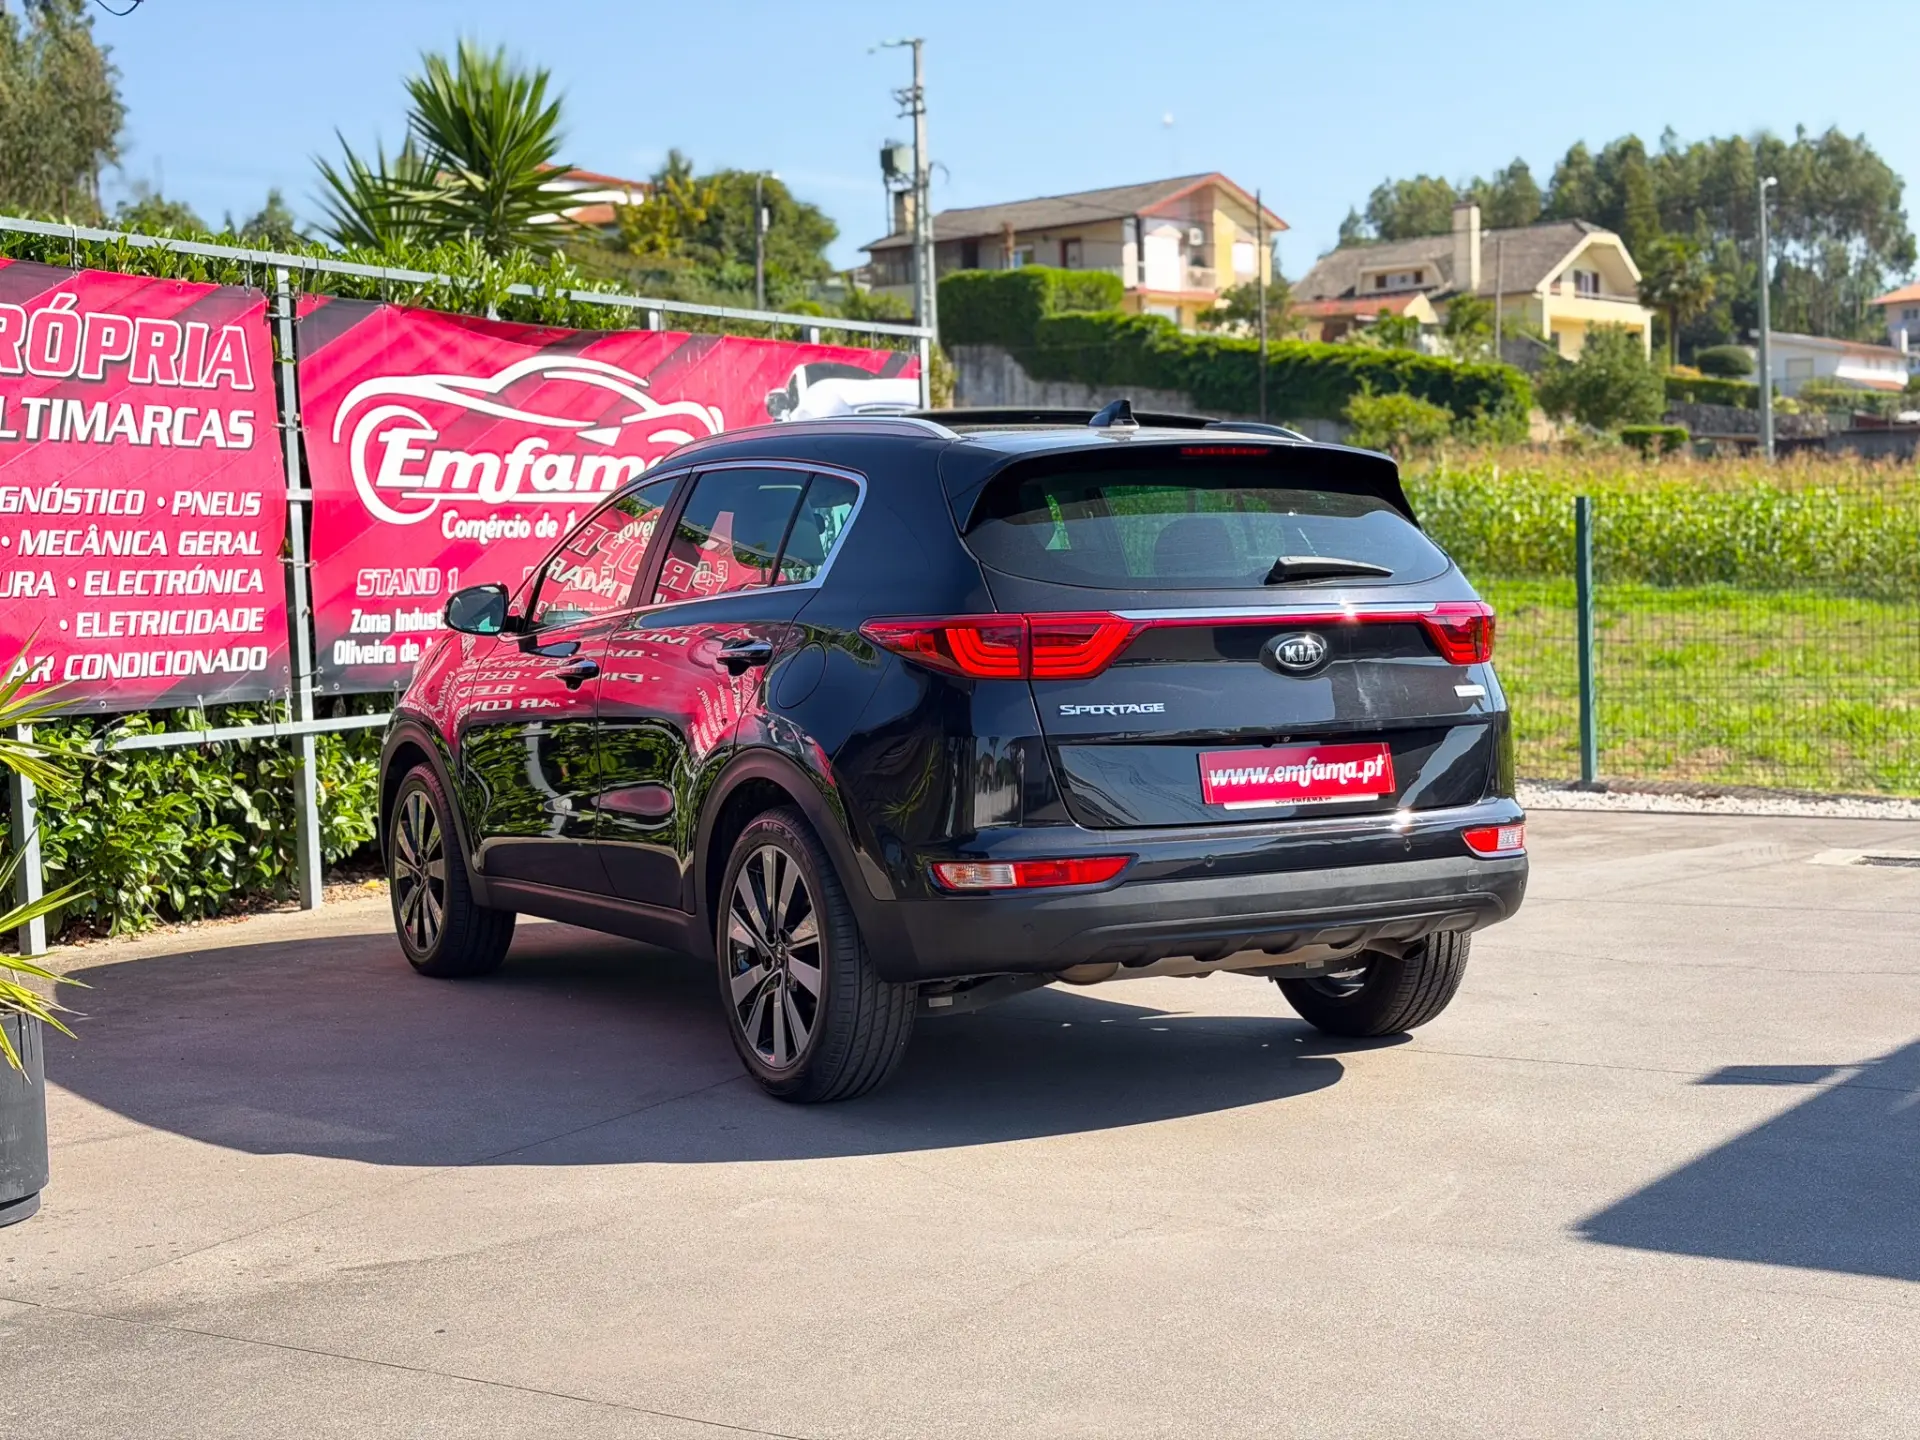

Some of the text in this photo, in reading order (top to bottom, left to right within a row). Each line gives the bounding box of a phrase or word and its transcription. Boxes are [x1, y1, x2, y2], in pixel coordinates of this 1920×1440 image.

[375, 427, 662, 505] Emfam
[0, 482, 262, 518] GNÓSTICO PNEUS
[18, 524, 262, 557] MECÂNICA GERAL
[442, 507, 531, 544] Comércio
[535, 512, 559, 539] de
[84, 564, 264, 597] ELECTRÓNICA
[356, 567, 459, 597] STAND 1
[76, 607, 265, 639] ELETRICIDADE
[350, 607, 449, 634] Zona Indust
[6, 646, 268, 685] AR CONDICIONADO
[333, 639, 397, 665] Oliveira
[400, 637, 420, 662] de
[1283, 644, 1317, 663] KIA
[1059, 702, 1165, 717] SPORTAGE
[1209, 754, 1385, 788] www.emfama.pt
